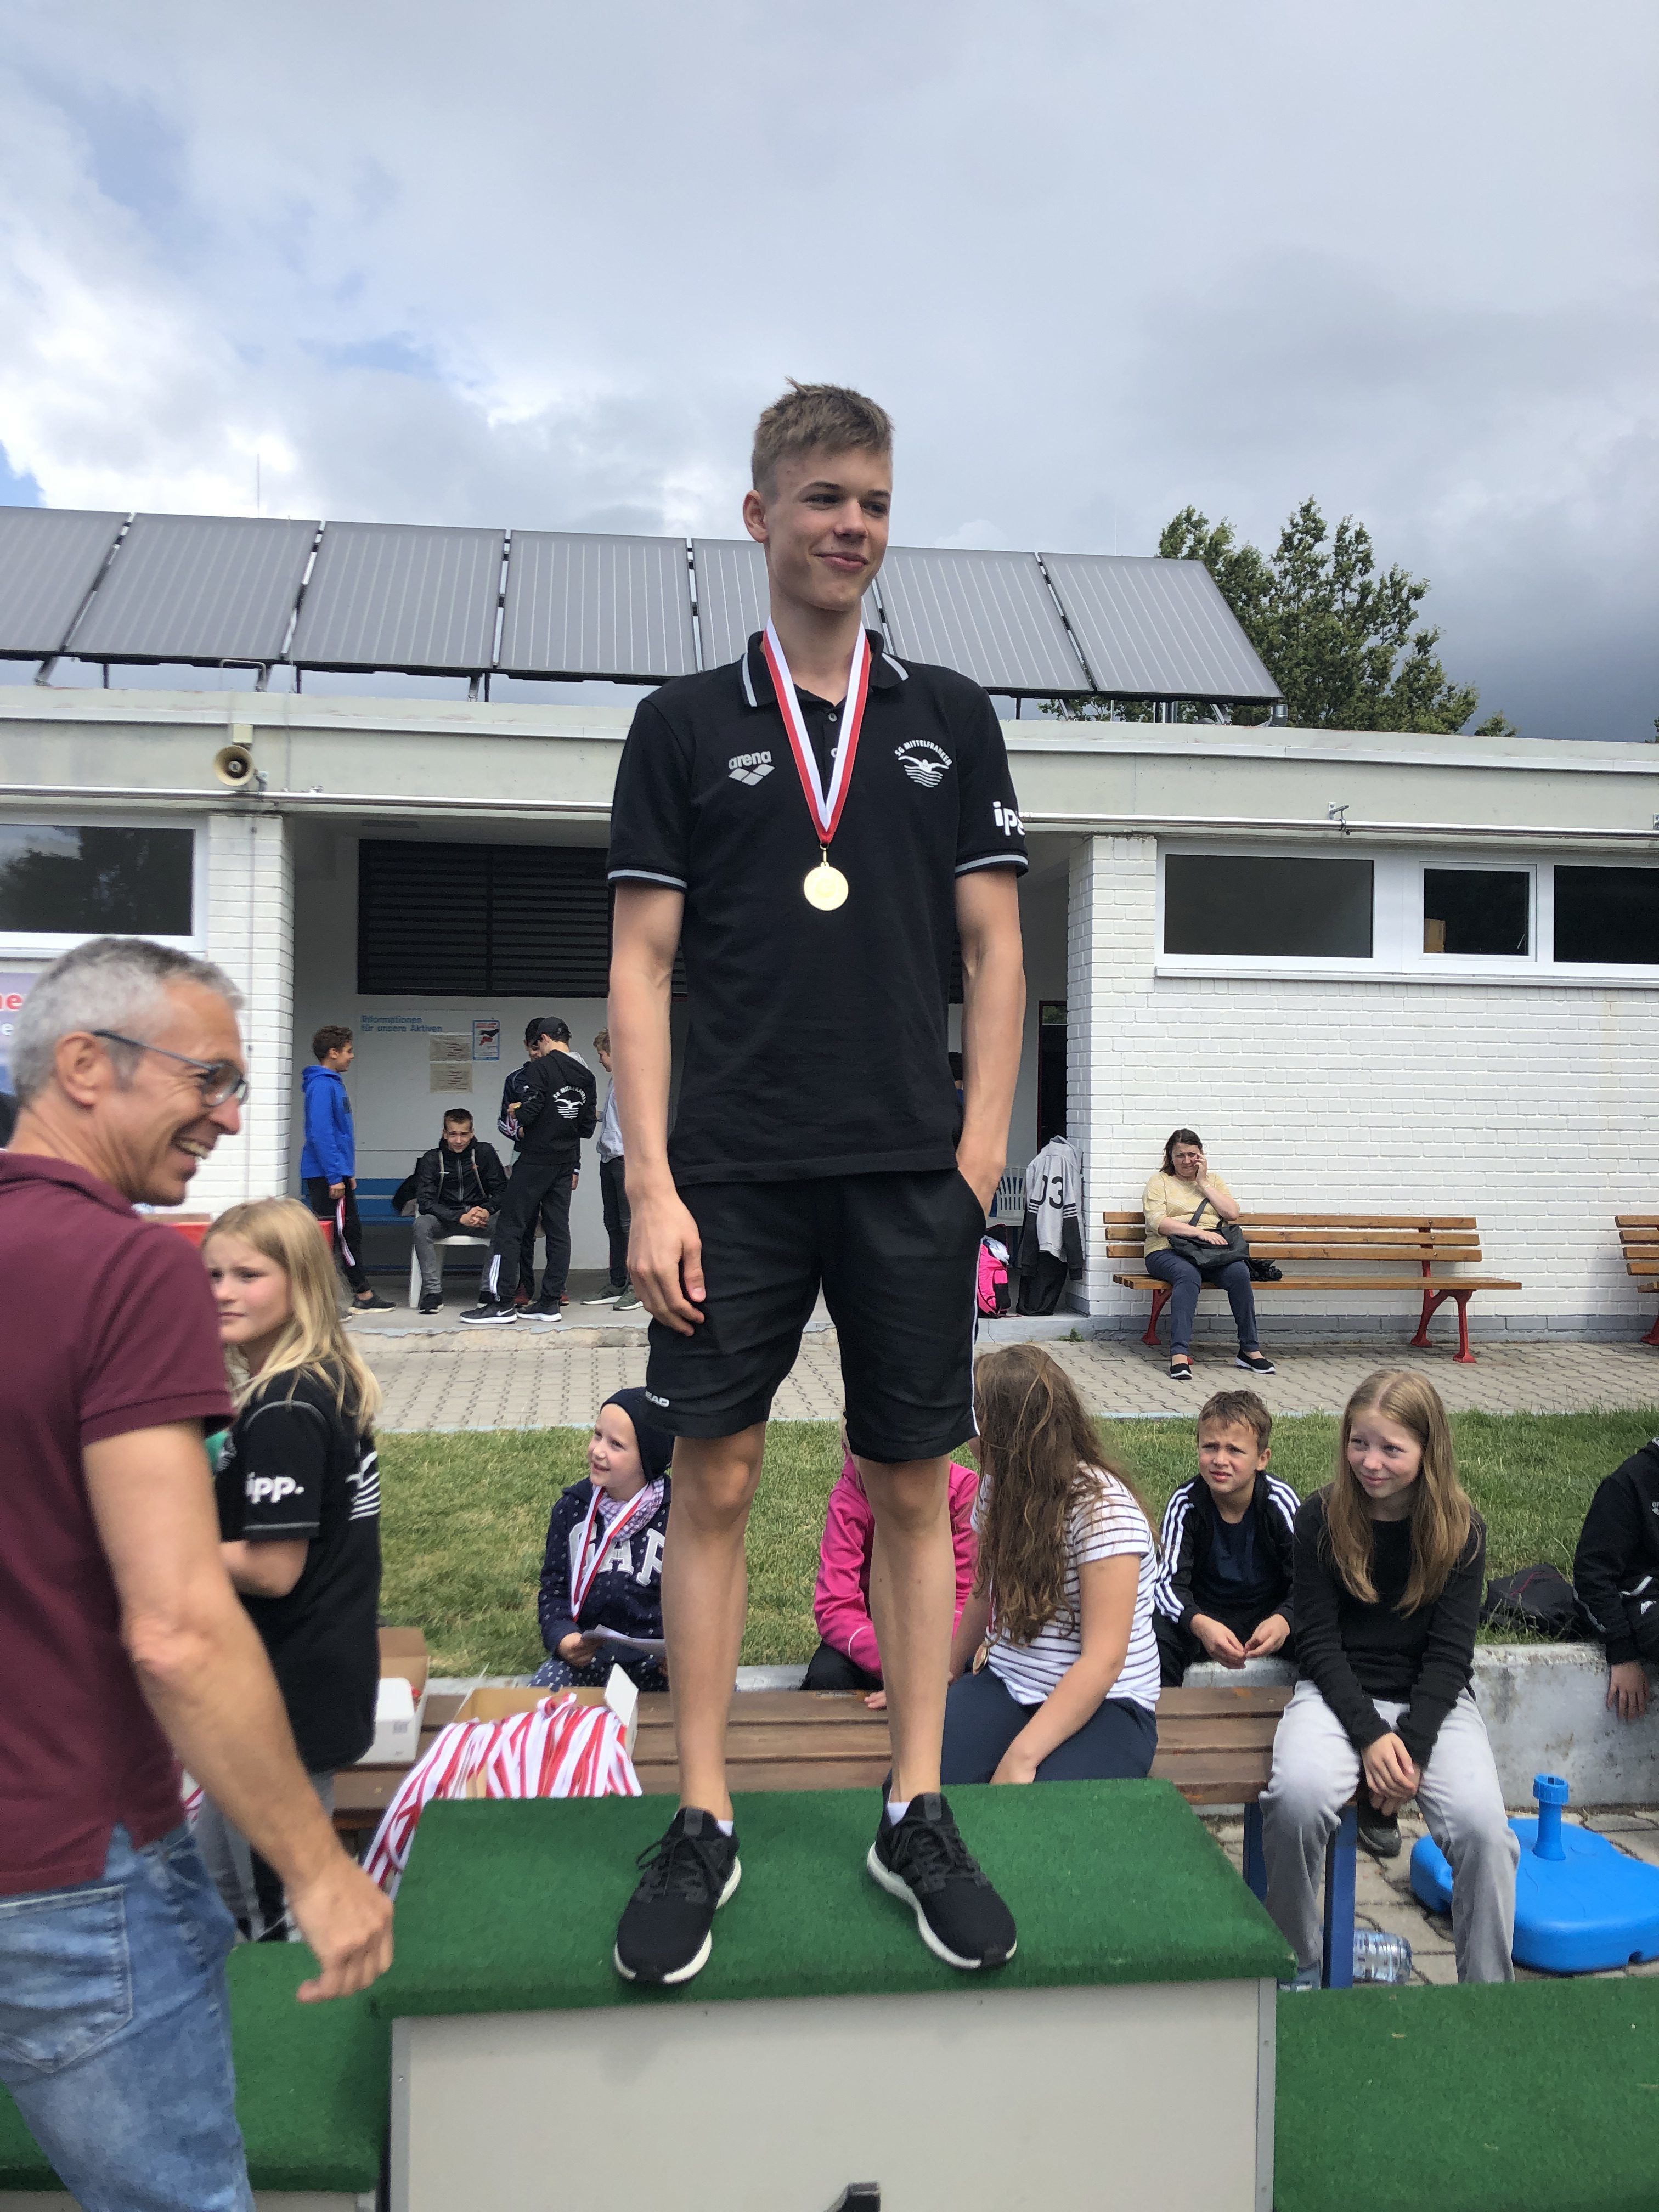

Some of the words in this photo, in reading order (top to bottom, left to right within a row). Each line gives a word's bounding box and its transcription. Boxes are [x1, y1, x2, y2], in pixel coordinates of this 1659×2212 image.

[728, 751, 772, 770] arena
[894, 746, 905, 757] SG
[903, 739, 953, 766] MITTELFRANKEN
[361, 1024, 374, 1032] für
[410, 1024, 443, 1032] Aktiven
[645, 1390, 670, 1407] EAD
